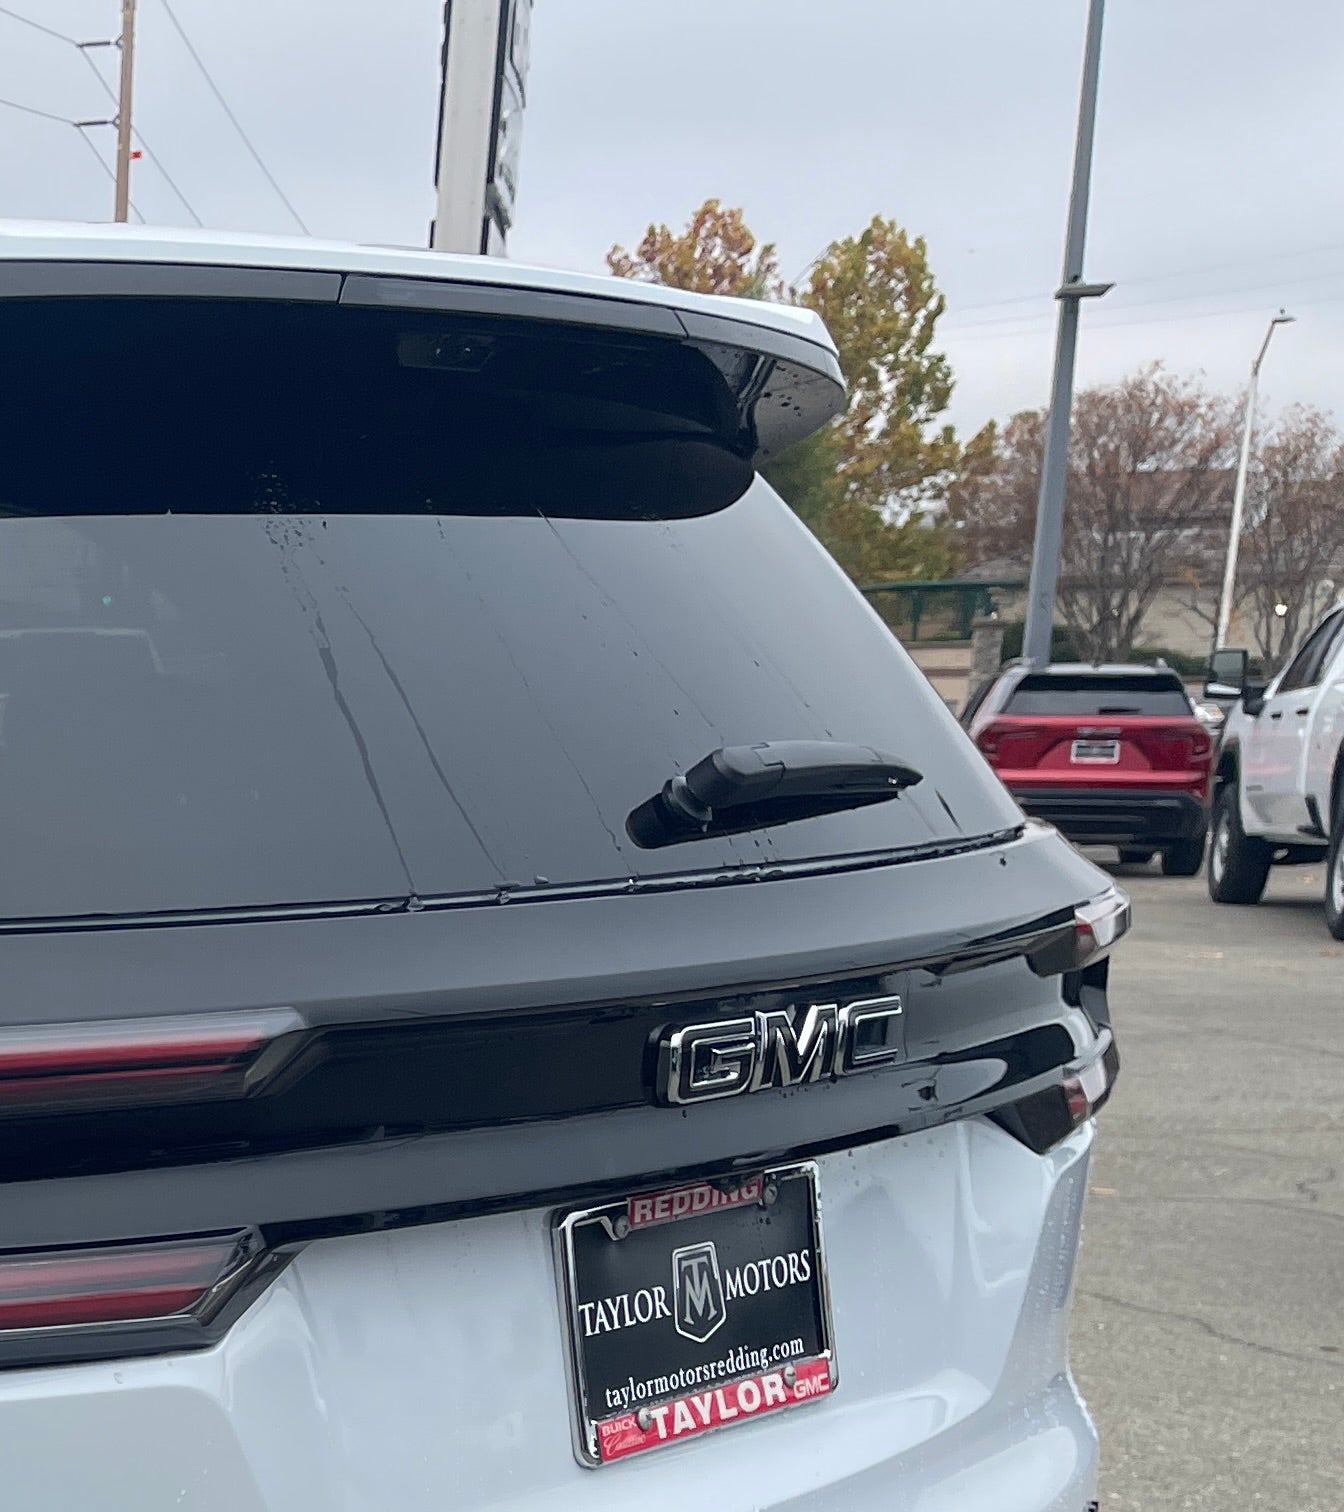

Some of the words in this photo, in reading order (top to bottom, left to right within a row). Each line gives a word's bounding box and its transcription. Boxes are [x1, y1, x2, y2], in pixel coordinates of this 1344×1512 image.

[657, 995, 902, 1105] GMC
[633, 1182, 759, 1224] REDDING
[578, 1286, 672, 1337] TAYLOR
[725, 1250, 811, 1301] MOTORS
[602, 1415, 637, 1437] BUICK
[651, 1372, 787, 1440] TAYLOR
[793, 1372, 830, 1400] GMC
[605, 1337, 805, 1409] taylormotorsredding.com
